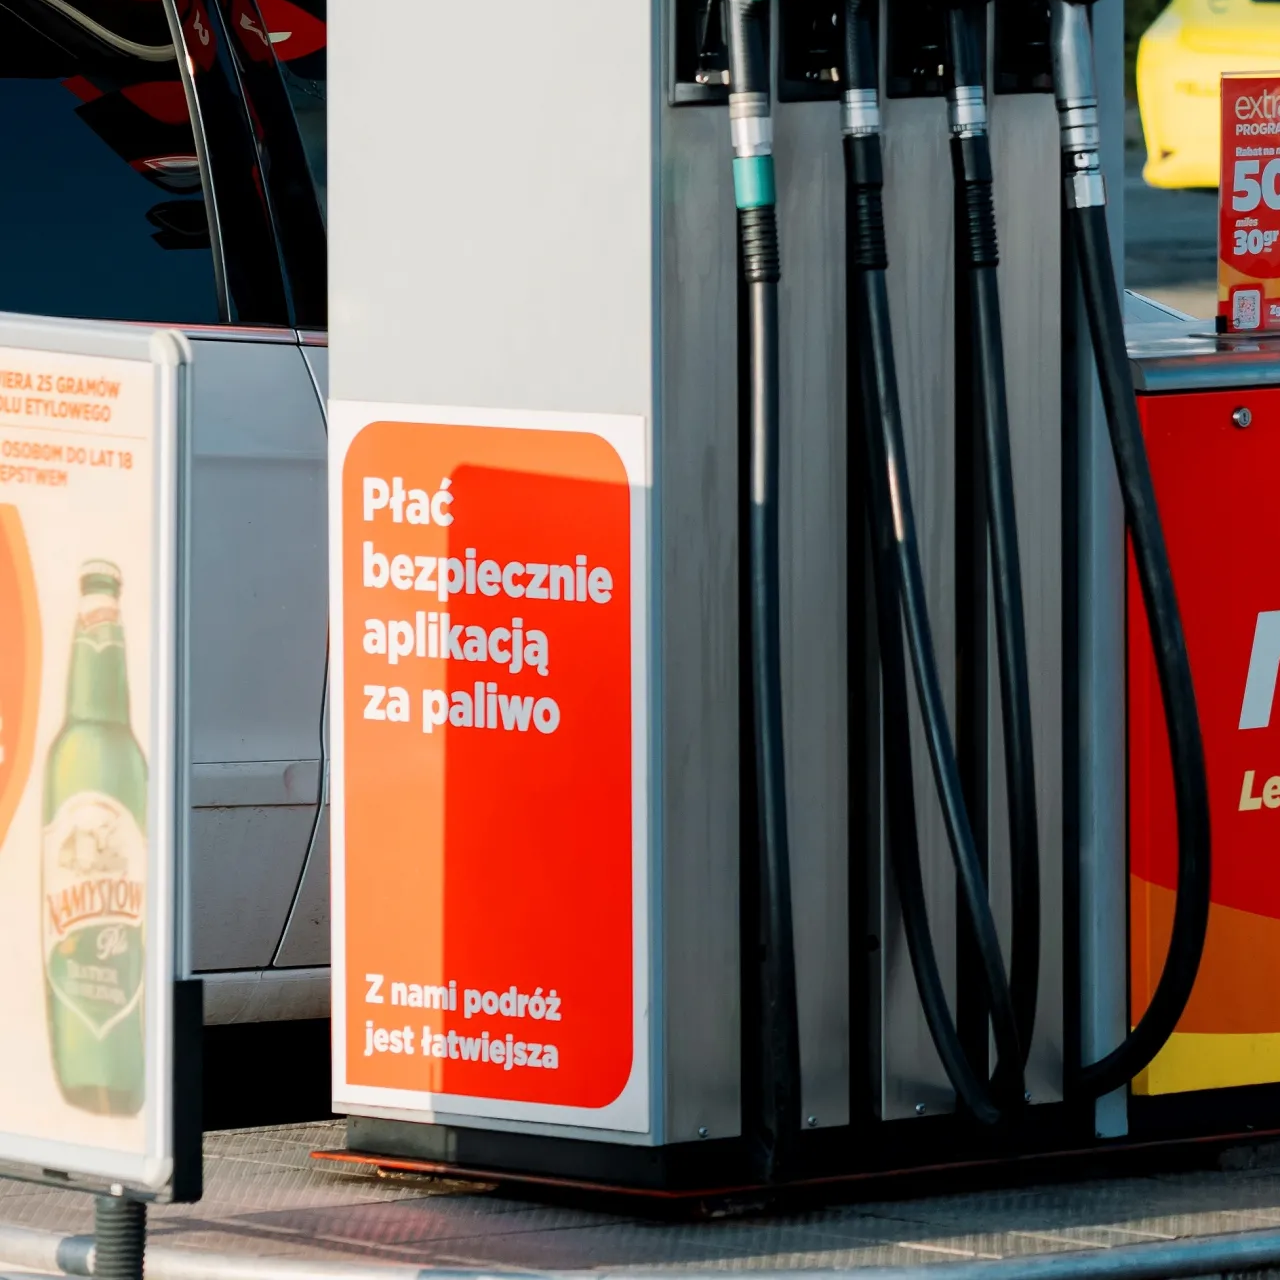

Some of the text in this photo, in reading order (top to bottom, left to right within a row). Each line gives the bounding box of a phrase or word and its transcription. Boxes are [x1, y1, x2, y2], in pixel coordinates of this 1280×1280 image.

[1236, 146, 1262, 156] Rabat
[1263, 148, 1275, 156] na
[1236, 217, 1258, 227] miles
[25, 398, 111, 422] ETYLOWEGO
[37, 375, 121, 399] 25 GRAMÓW
[2, 441, 133, 469] OSOBOM DO LAT 18
[363, 477, 454, 526] Płać
[363, 541, 613, 604] bezpiecznie
[363, 610, 548, 676] aplikacją
[363, 681, 560, 734] za paliwo
[365, 974, 562, 1021] Z nami podróż
[364, 1021, 559, 1070] jest łatwiejsza
